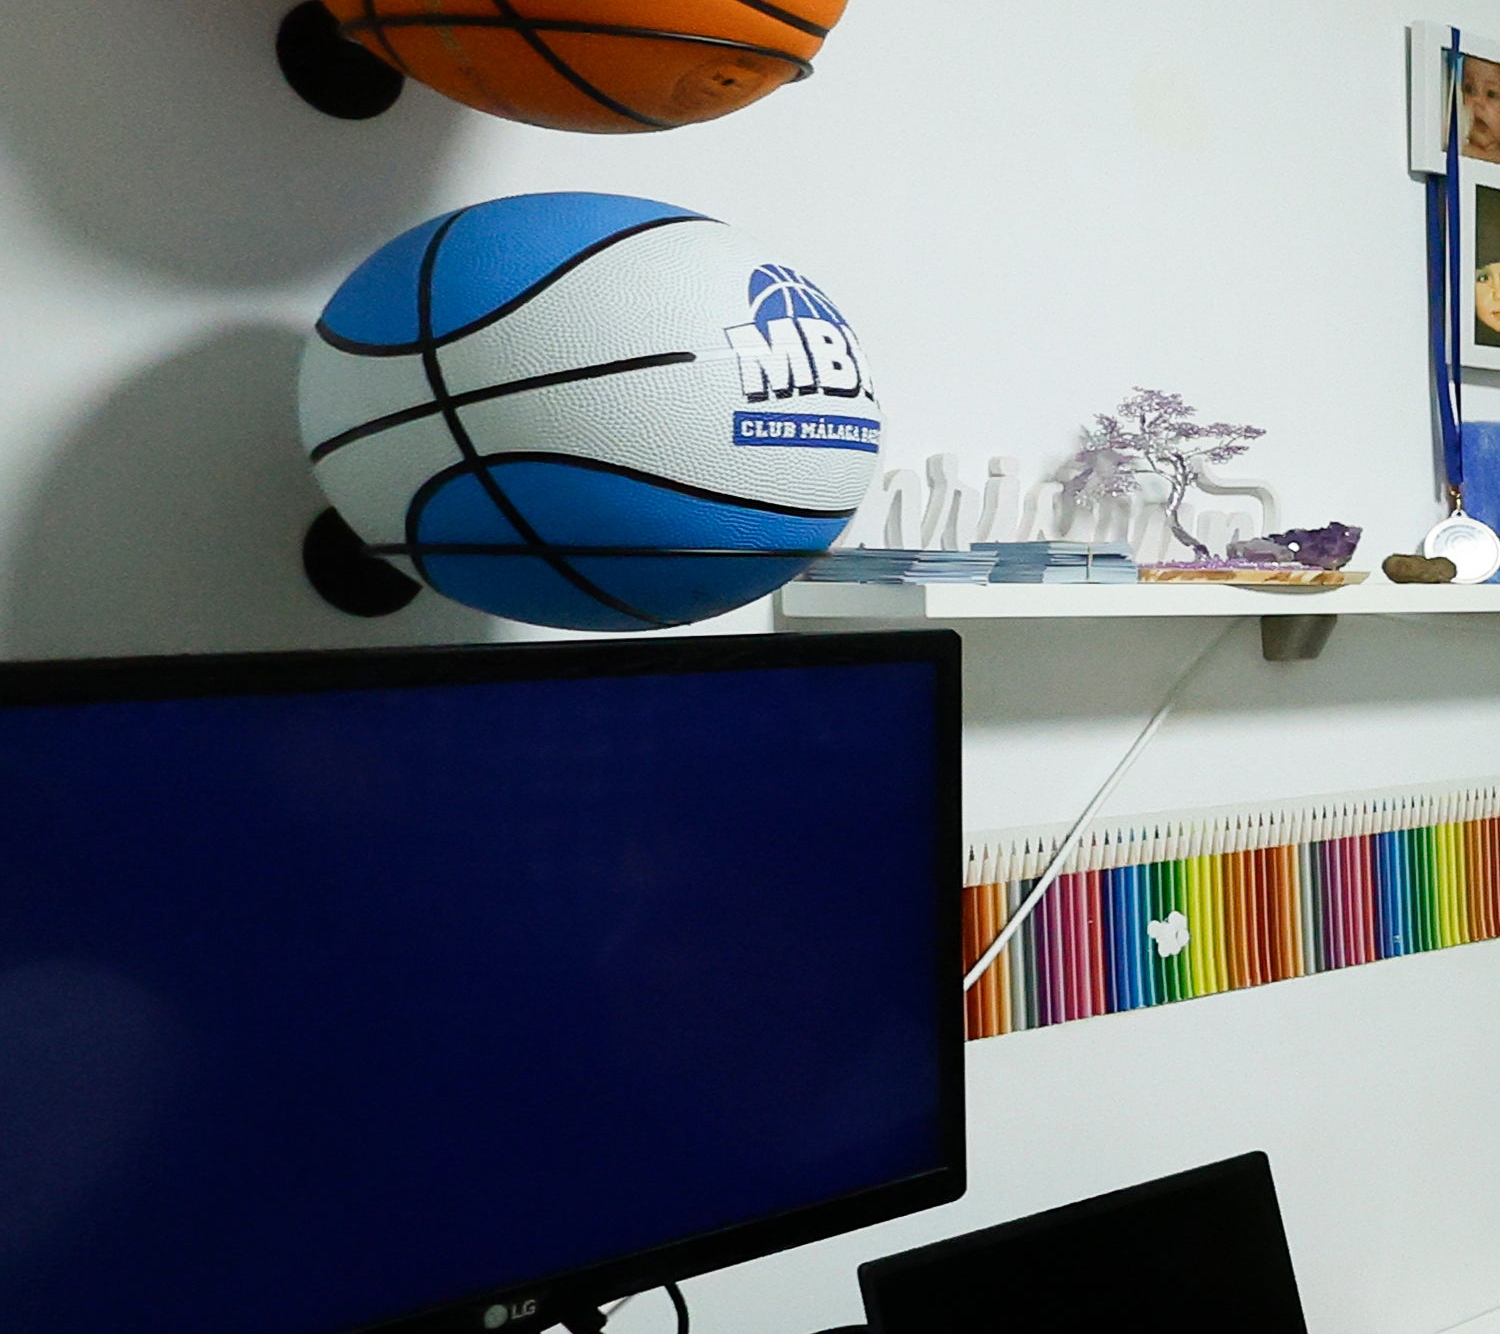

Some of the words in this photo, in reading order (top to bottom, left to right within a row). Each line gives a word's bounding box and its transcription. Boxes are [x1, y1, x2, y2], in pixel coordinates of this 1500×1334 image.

[724, 317, 876, 404] MB
[740, 418, 796, 438] CLUB
[800, 417, 860, 441] MÁLAGA
[511, 1299, 537, 1320] LG
